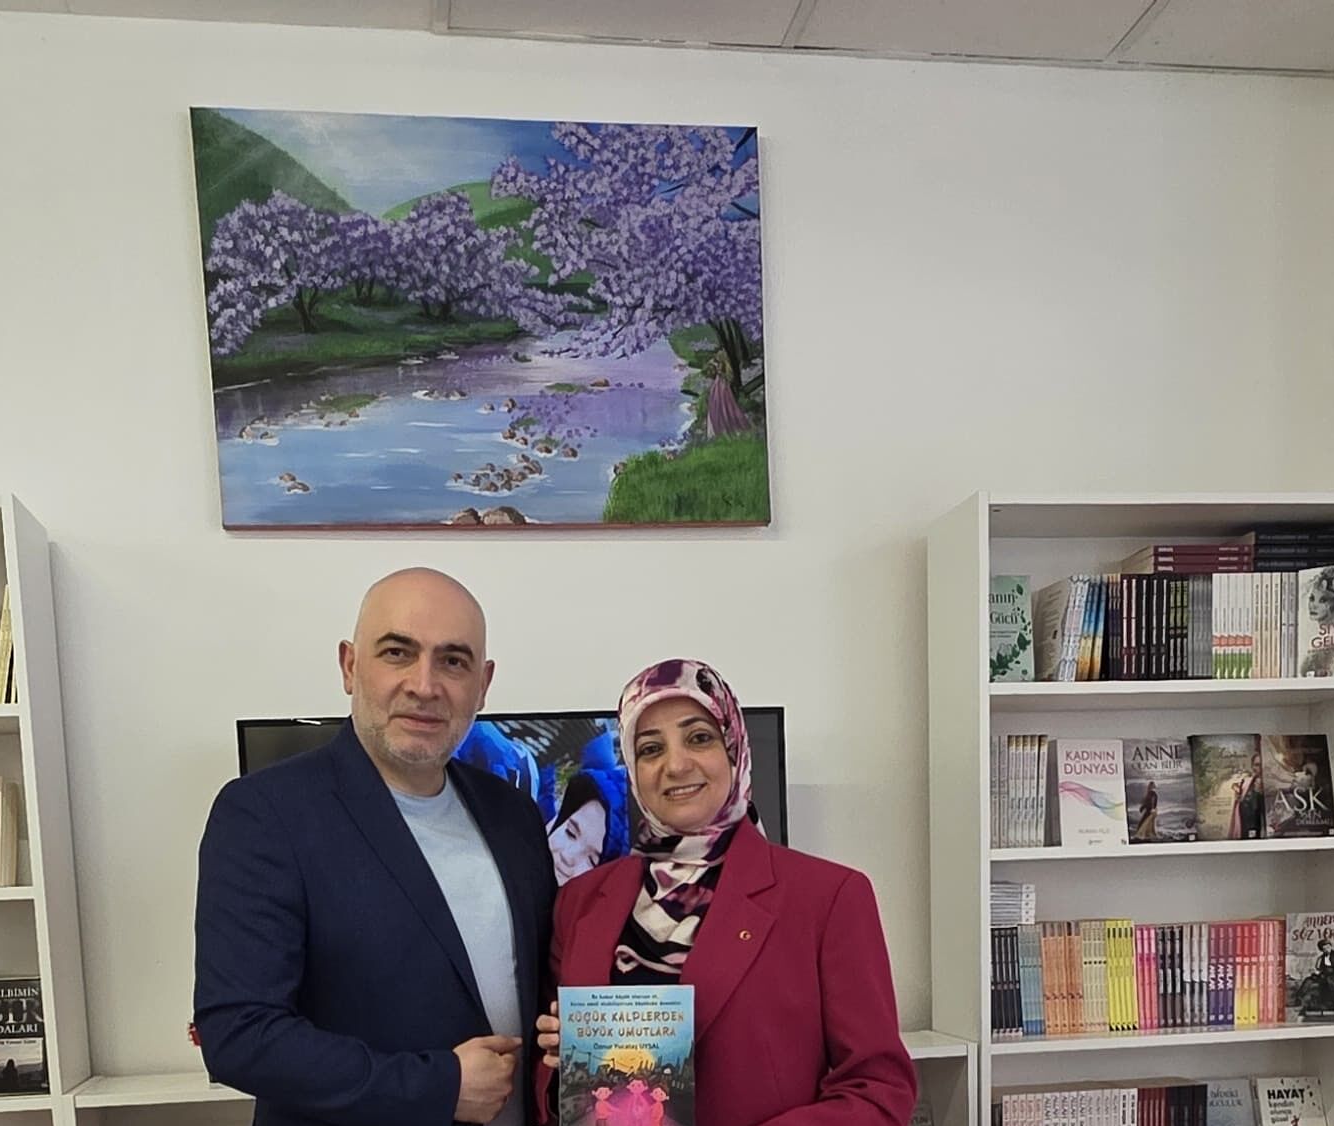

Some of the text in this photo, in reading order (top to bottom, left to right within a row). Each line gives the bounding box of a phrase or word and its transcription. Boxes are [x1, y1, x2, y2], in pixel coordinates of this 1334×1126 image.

[1065, 750, 1116, 761] KADININ
[1132, 744, 1182, 761] ANNE
[1064, 762, 1118, 775] DÜNYASI
[568, 1010, 684, 1024] KÜÇÜK KALPLERDEN
[577, 1027, 676, 1038] BÜYÜK UMUTLARA
[1267, 1089, 1305, 1103] HAYAT
